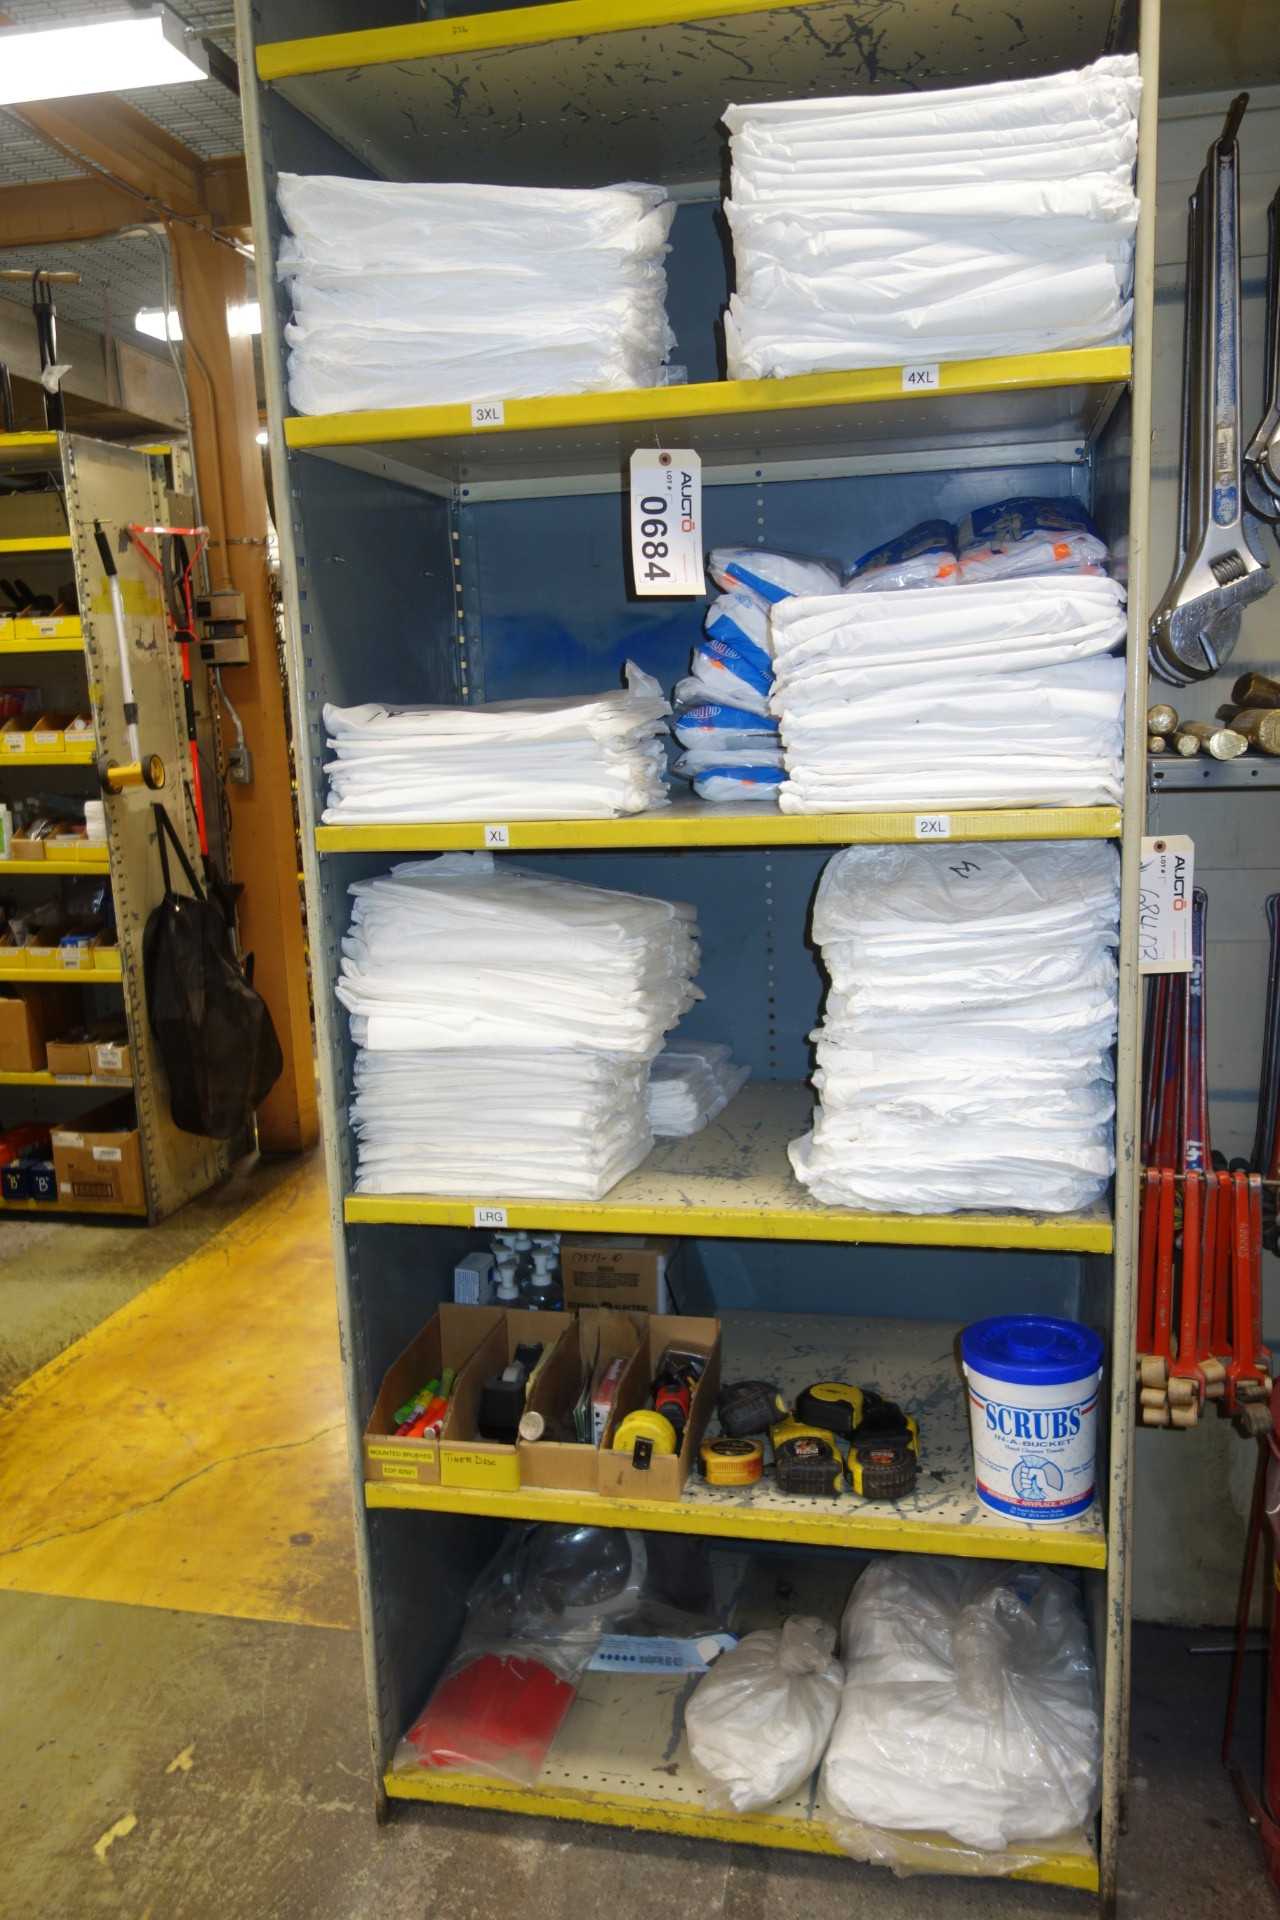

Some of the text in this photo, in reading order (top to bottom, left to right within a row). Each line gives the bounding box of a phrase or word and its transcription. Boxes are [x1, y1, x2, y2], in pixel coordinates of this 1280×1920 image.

[908, 371, 936, 384] 4XL
[476, 408, 501, 421] 3XL
[640, 496, 671, 581] 0684
[920, 821, 947, 833] 2XL
[490, 831, 505, 842] XL
[479, 1211, 503, 1222] LRG
[985, 1402, 1081, 1440] SCRUBS
